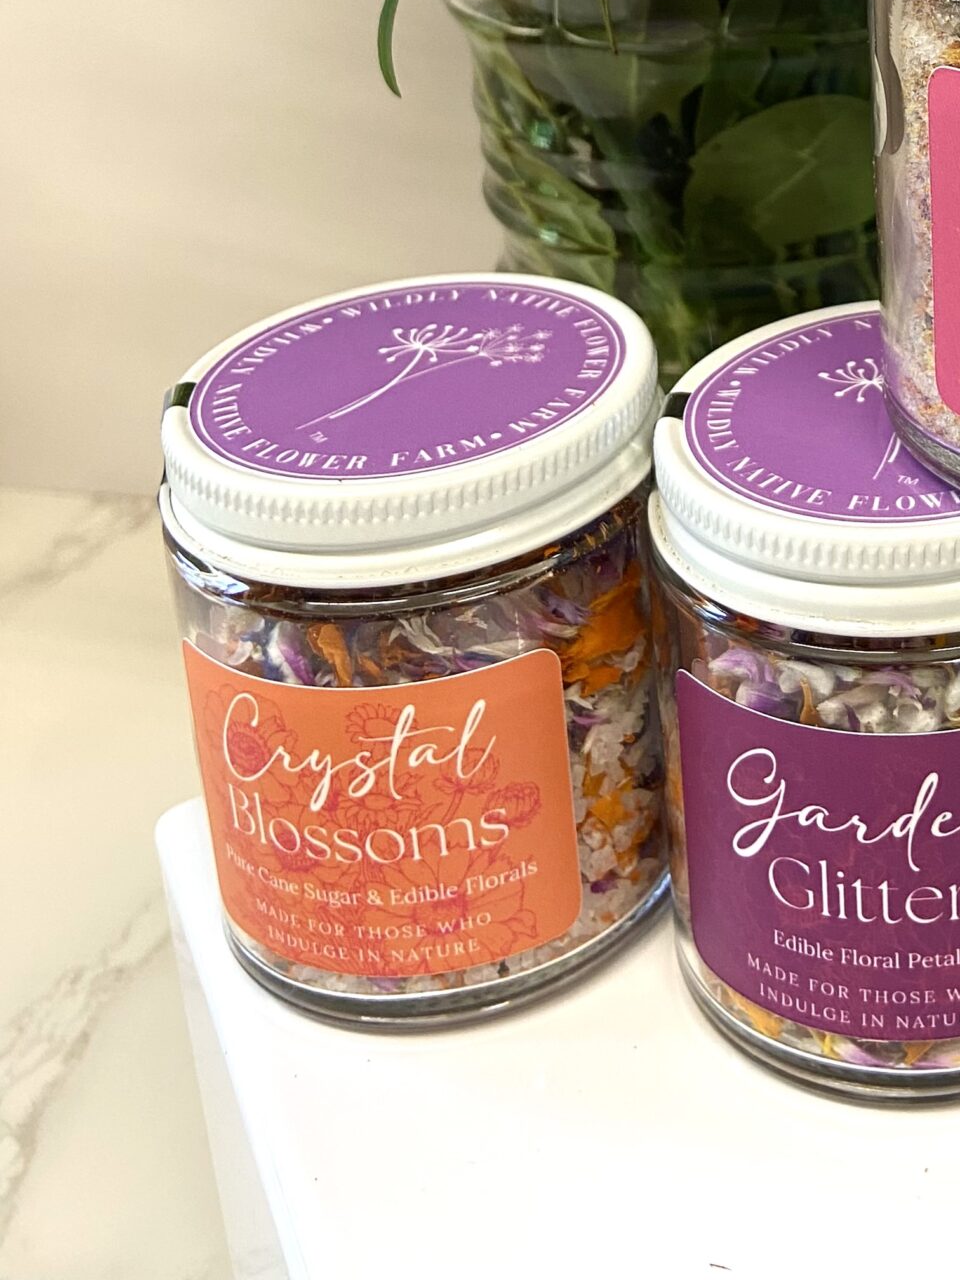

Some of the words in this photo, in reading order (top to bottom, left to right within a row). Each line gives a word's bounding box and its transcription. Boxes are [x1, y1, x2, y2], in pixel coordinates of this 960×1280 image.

[340, 290, 461, 317] WILDLY
[231, 323, 323, 374] WILDLY
[573, 318, 609, 379] FLOWER
[732, 328, 833, 374] WILDLY
[212, 383, 252, 440] NATIVE
[508, 387, 587, 433] FARM
[242, 438, 368, 470] FLOWER
[309, 431, 328, 444] TM
[390, 434, 486, 467] FARM
[707, 389, 742, 451] WILDLY
[726, 455, 832, 506] NATIVE
[897, 475, 919, 485] TM
[223, 692, 497, 811] Crystal
[228, 782, 509, 863] Blossoms
[226, 843, 254, 876] Pure
[258, 863, 299, 895] Cane
[304, 879, 360, 909] Sugar
[367, 890, 381, 906] &
[390, 882, 458, 905] Edible
[465, 861, 538, 893] Florals
[255, 898, 298, 927] MADE
[308, 919, 345, 937] FOR
[354, 923, 427, 940] THOSE
[438, 911, 492, 932] WHO
[268, 925, 349, 960] INDULGE
[359, 949, 380, 962] IN
[392, 938, 481, 962] NATURE
[773, 929, 834, 961] Edible
[840, 947, 900, 969] Floral
[747, 952, 799, 987] MADE
[809, 978, 849, 1000] FOR
[859, 987, 937, 1005] THOSE
[759, 982, 850, 1024] INDULGE
[862, 1012, 885, 1027] IN
